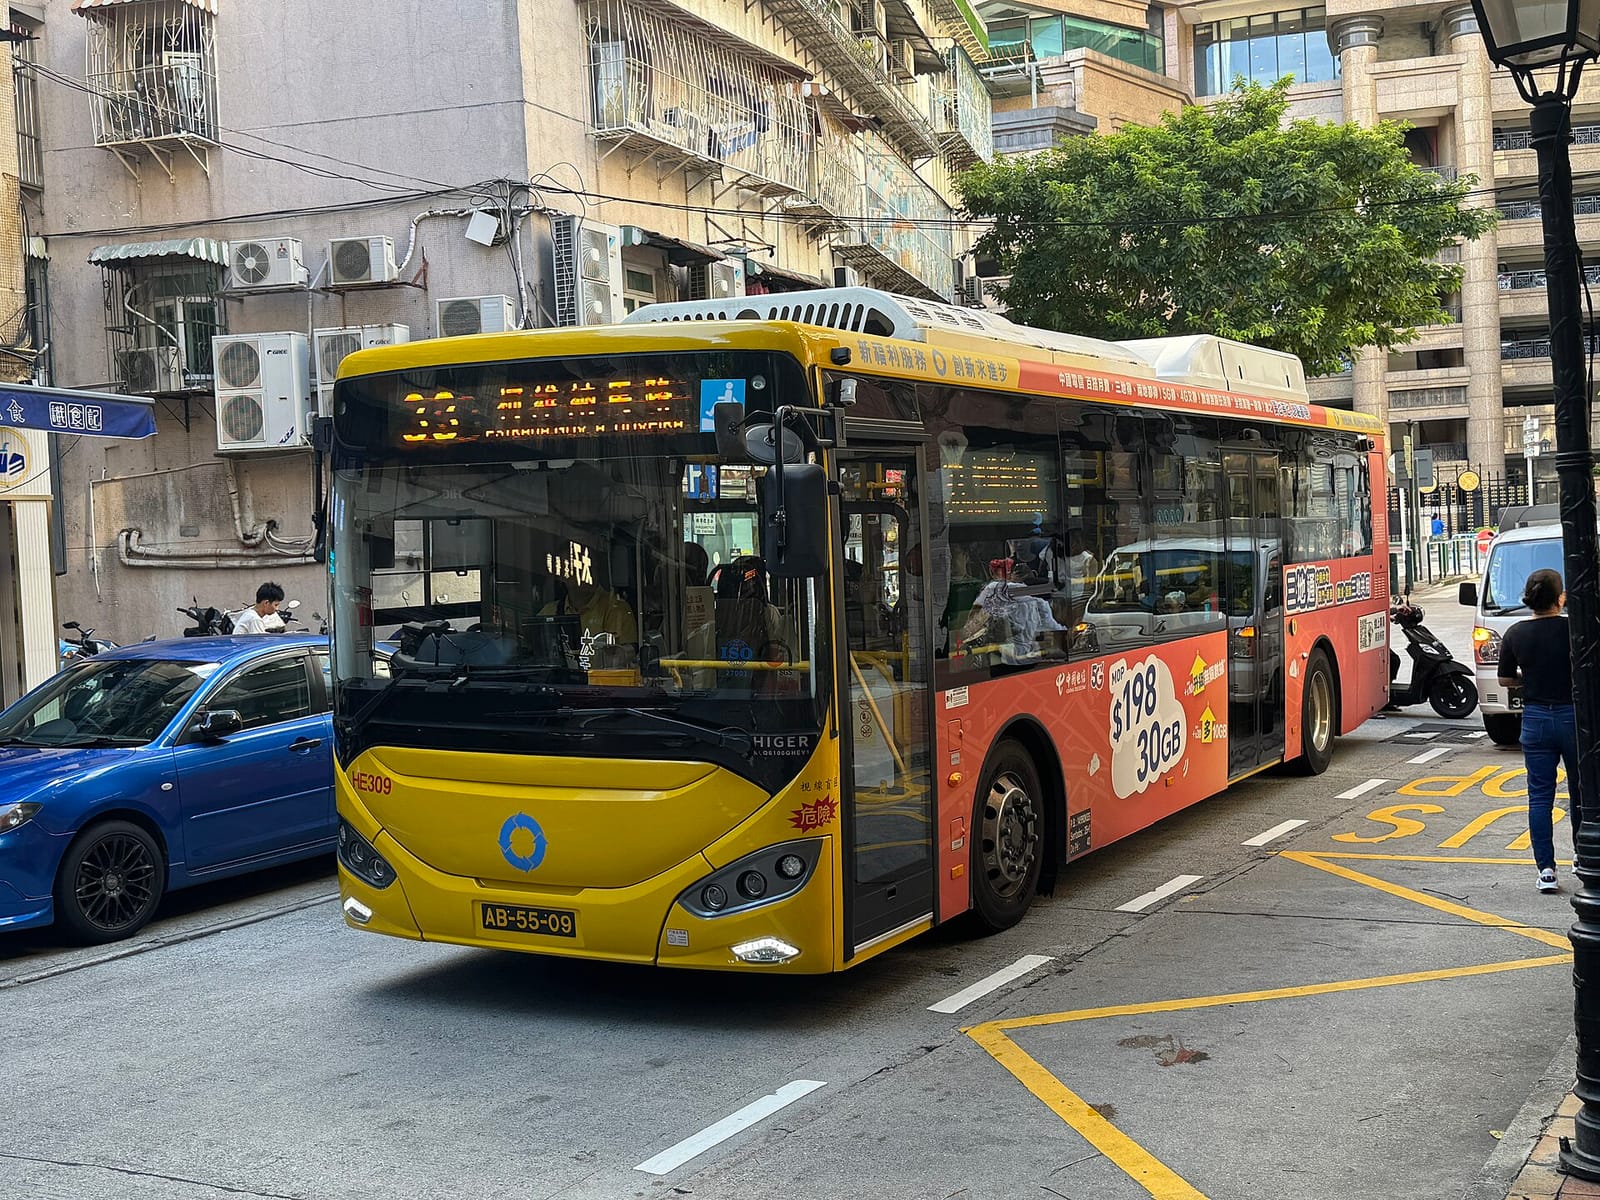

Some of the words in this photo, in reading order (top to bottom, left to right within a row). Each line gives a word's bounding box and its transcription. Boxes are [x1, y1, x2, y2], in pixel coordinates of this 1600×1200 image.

[857, 339, 927, 371] 新福利服務
[951, 354, 1008, 383] 創新求進步
[720, 646, 753, 660] ISO
[1111, 665, 1125, 686] MOP
[1113, 664, 1157, 743] $198
[753, 736, 809, 748] HIGER
[1136, 720, 1181, 783] 30GB
[351, 771, 392, 795] HE309
[800, 805, 831, 825] 危險
[484, 906, 573, 934] AB-55-09
